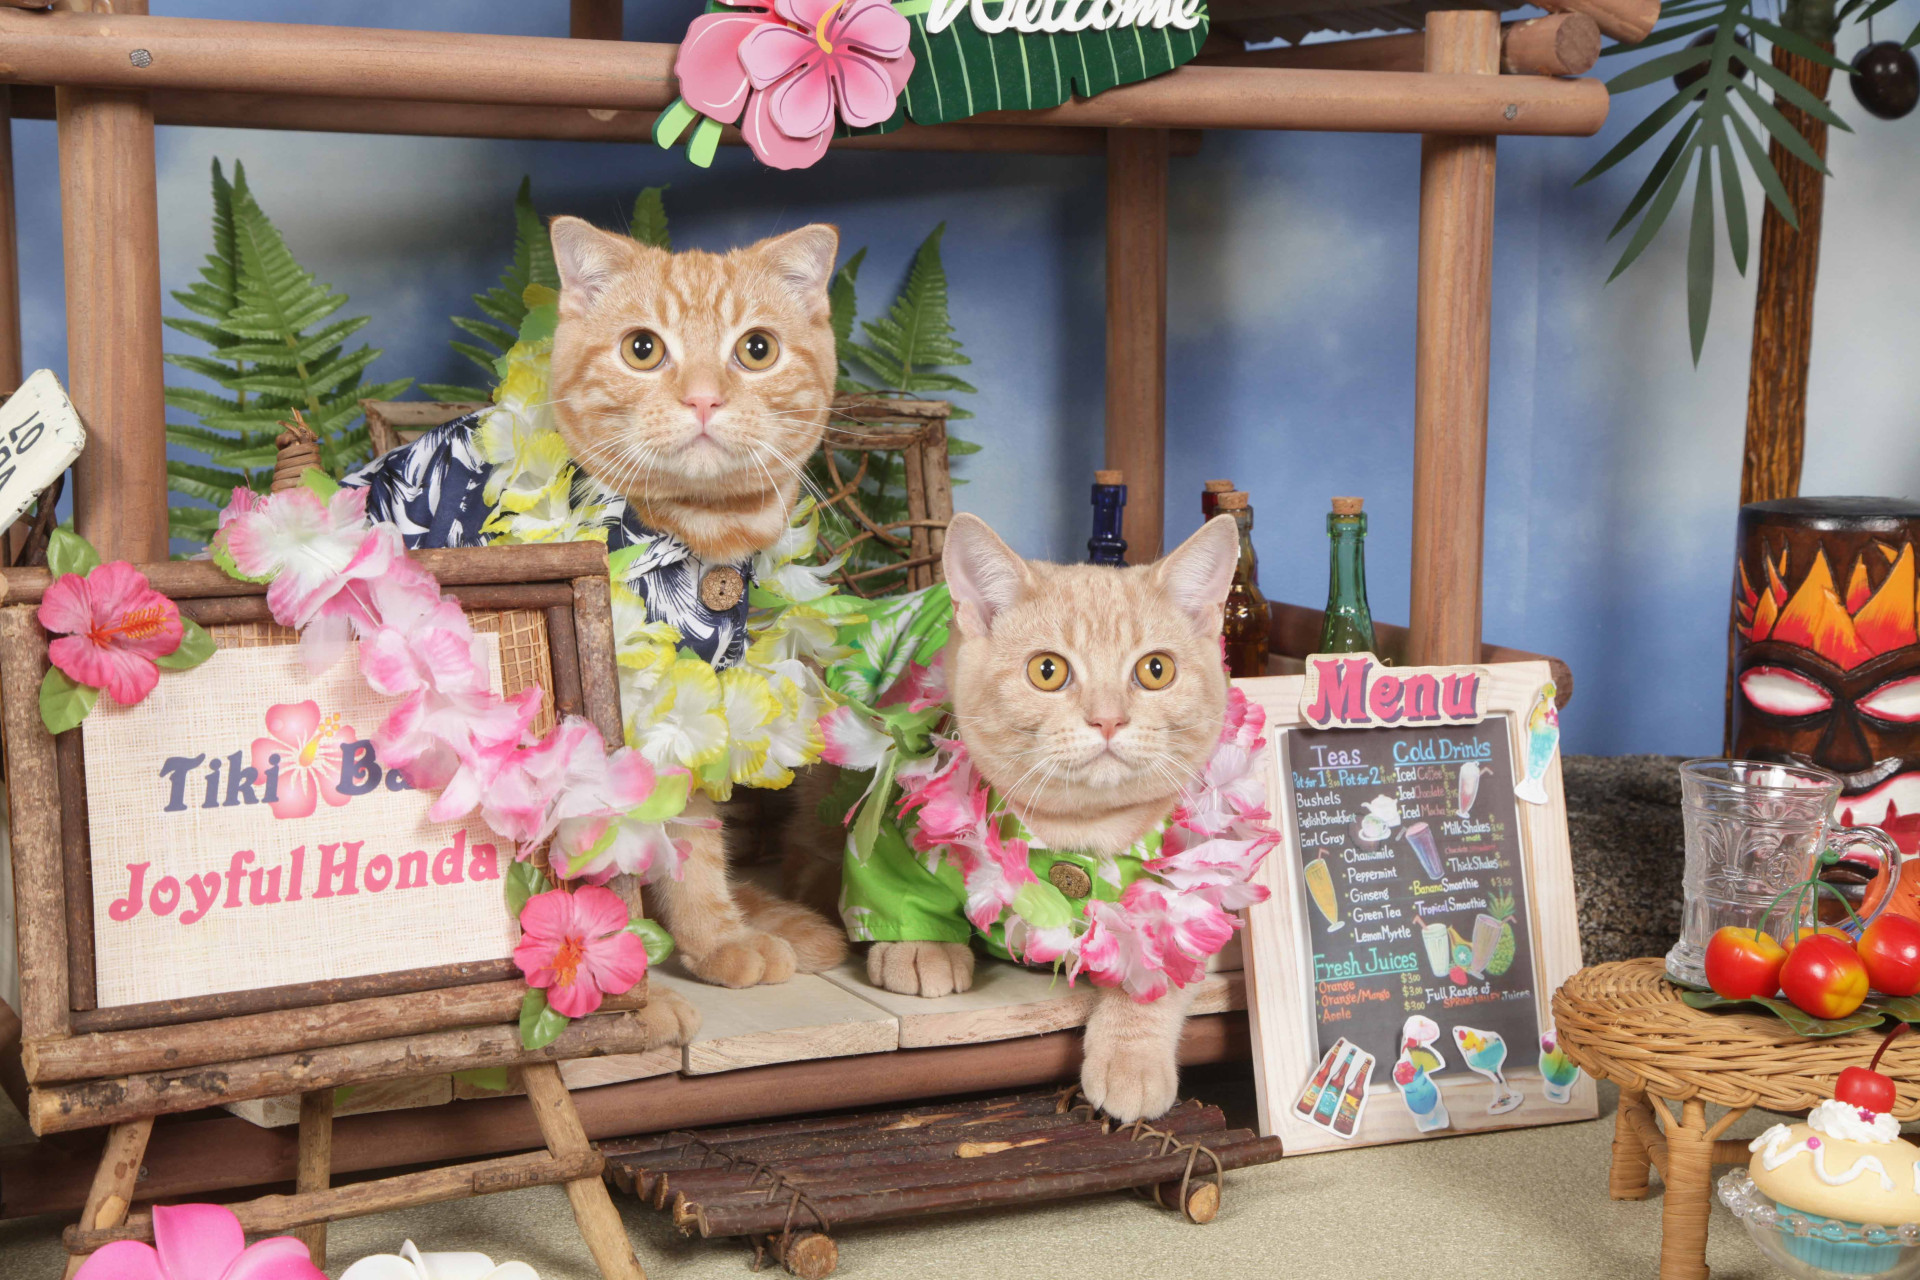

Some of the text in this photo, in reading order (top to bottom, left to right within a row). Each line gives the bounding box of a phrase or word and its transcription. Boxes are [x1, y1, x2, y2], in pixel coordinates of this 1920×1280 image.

[1306, 657, 1481, 725] Menu
[1309, 744, 1361, 768] Teas
[1392, 736, 1492, 762] Cold Drinks
[159, 739, 417, 812] Tiki Ba
[1292, 771, 1305, 788] Pot
[1305, 776, 1317, 788] for
[1317, 770, 1327, 788] 1
[1338, 769, 1357, 787] Pot
[1357, 773, 1369, 785] for
[1369, 766, 1381, 785] 2
[1394, 767, 1417, 782] Iced
[1417, 766, 1443, 781] Coffee
[1296, 791, 1342, 808] Bushels
[1398, 786, 1415, 801] Iced
[1298, 810, 1357, 829] English Breakfast
[1401, 804, 1421, 819] Iced
[1443, 820, 1462, 836] Milk
[1462, 818, 1491, 835] Shakes
[1300, 831, 1345, 848] Earl Gray
[1343, 844, 1395, 863] Chamomile
[1448, 857, 1474, 873] Thick
[1473, 855, 1499, 870] Shakes
[108, 829, 501, 925] Joyful Honda
[1347, 866, 1398, 884] Peppermint
[1350, 887, 1389, 903] Ginseng
[1413, 880, 1442, 896] Banana
[1441, 877, 1479, 893] Smoothie
[1353, 904, 1402, 923] Green Tea
[1414, 896, 1487, 917] Tropical Smoothie
[1354, 925, 1412, 943] Lemon Myrtle
[1313, 947, 1418, 979] Fresh Juices
[1318, 980, 1356, 994] Orange
[1425, 982, 1491, 1004] Full Range of
[1321, 988, 1391, 1007] Orange/Mango
[1322, 1007, 1352, 1024] Apple
